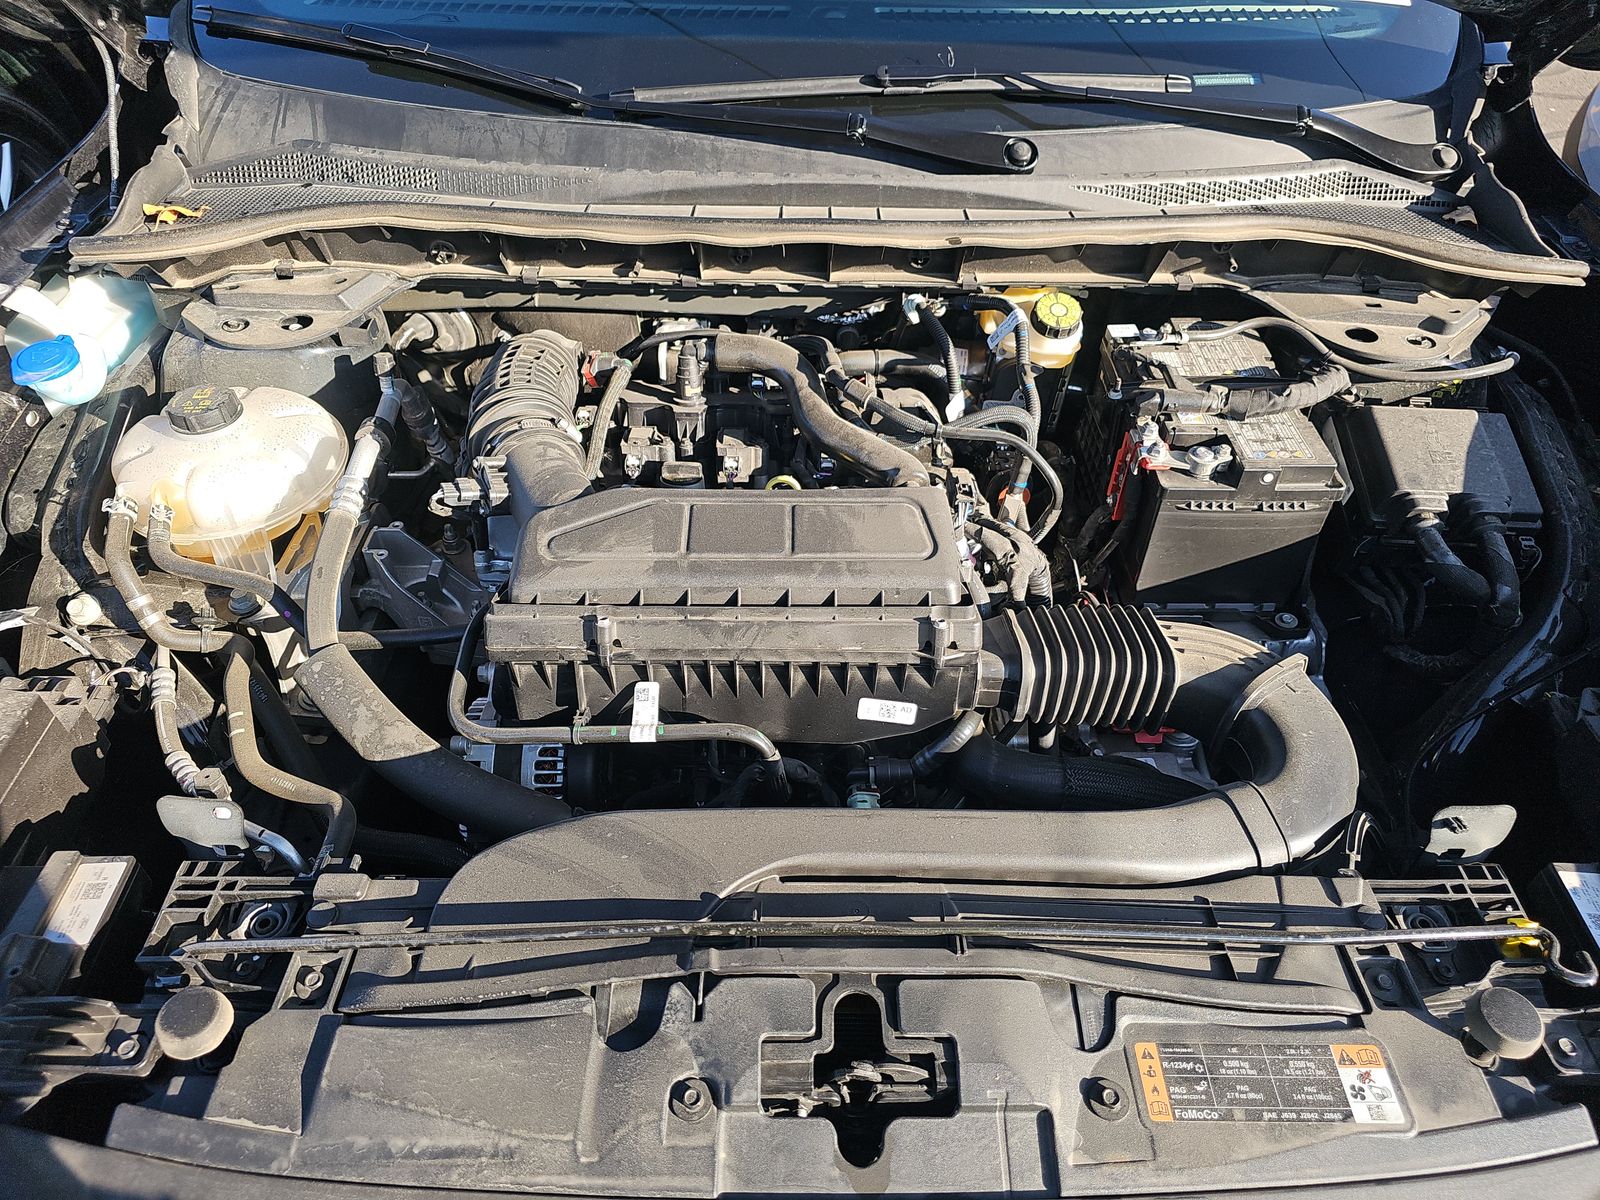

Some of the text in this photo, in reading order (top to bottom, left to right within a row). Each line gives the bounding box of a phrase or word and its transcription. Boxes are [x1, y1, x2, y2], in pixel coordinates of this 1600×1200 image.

[1162, 1061, 1194, 1071] R-1234yf
[1223, 1060, 1249, 1069] 0.500 kg
[1174, 1109, 1218, 1119] FoMoCo
